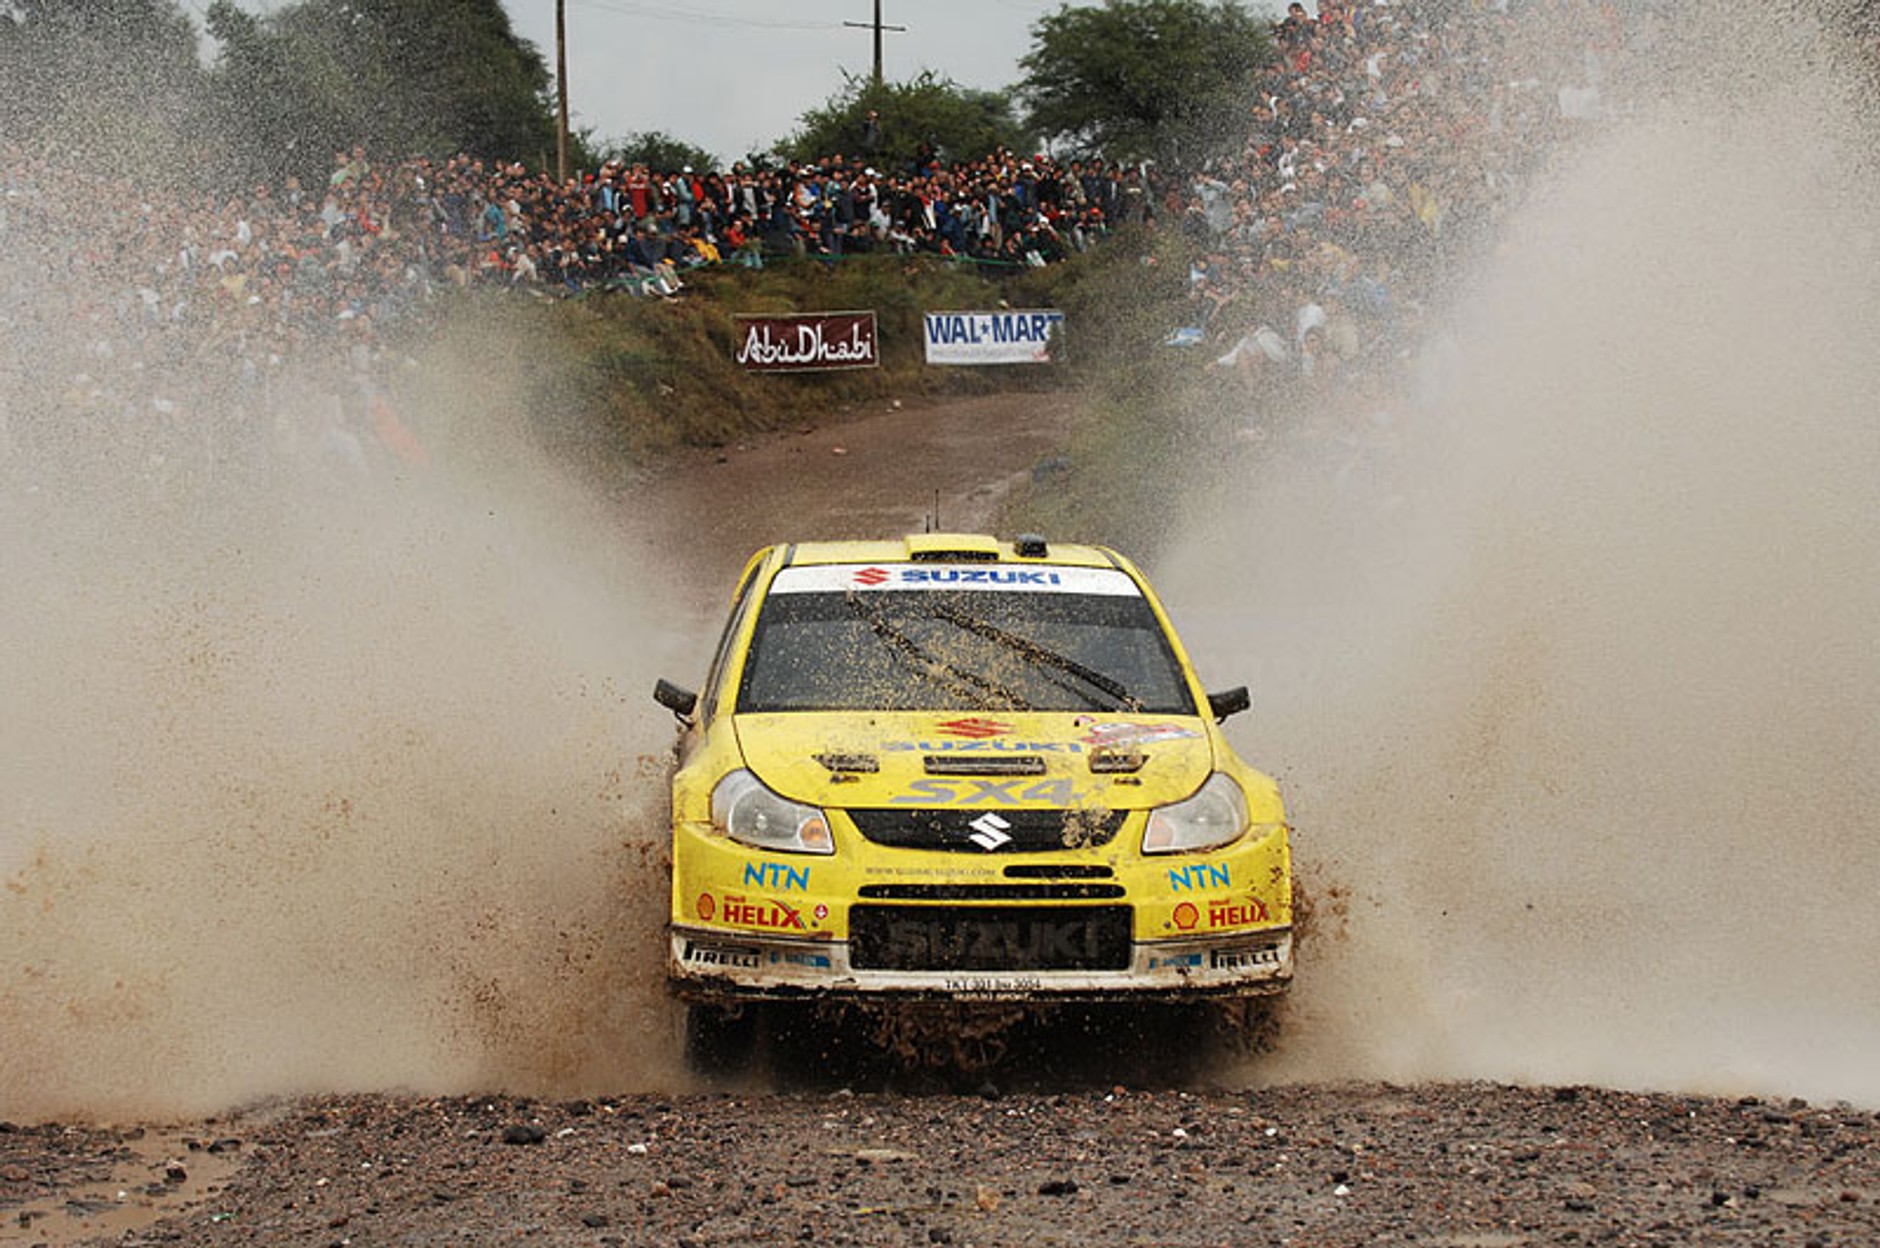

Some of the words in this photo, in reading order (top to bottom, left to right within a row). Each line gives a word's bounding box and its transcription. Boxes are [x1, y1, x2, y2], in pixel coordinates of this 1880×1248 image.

[736, 325, 799, 363] Abu
[798, 323, 872, 362] Dhabi
[901, 569, 1062, 585] SUZUKI
[880, 740, 1082, 753] SUZUKI
[888, 778, 1084, 805] SX4
[744, 862, 810, 891] NTN
[1168, 863, 1230, 892] NTN
[723, 899, 805, 929] HELIX
[1209, 896, 1271, 927] HELIX
[683, 940, 761, 968] PIRELLI
[885, 919, 1100, 963] SUZUKI
